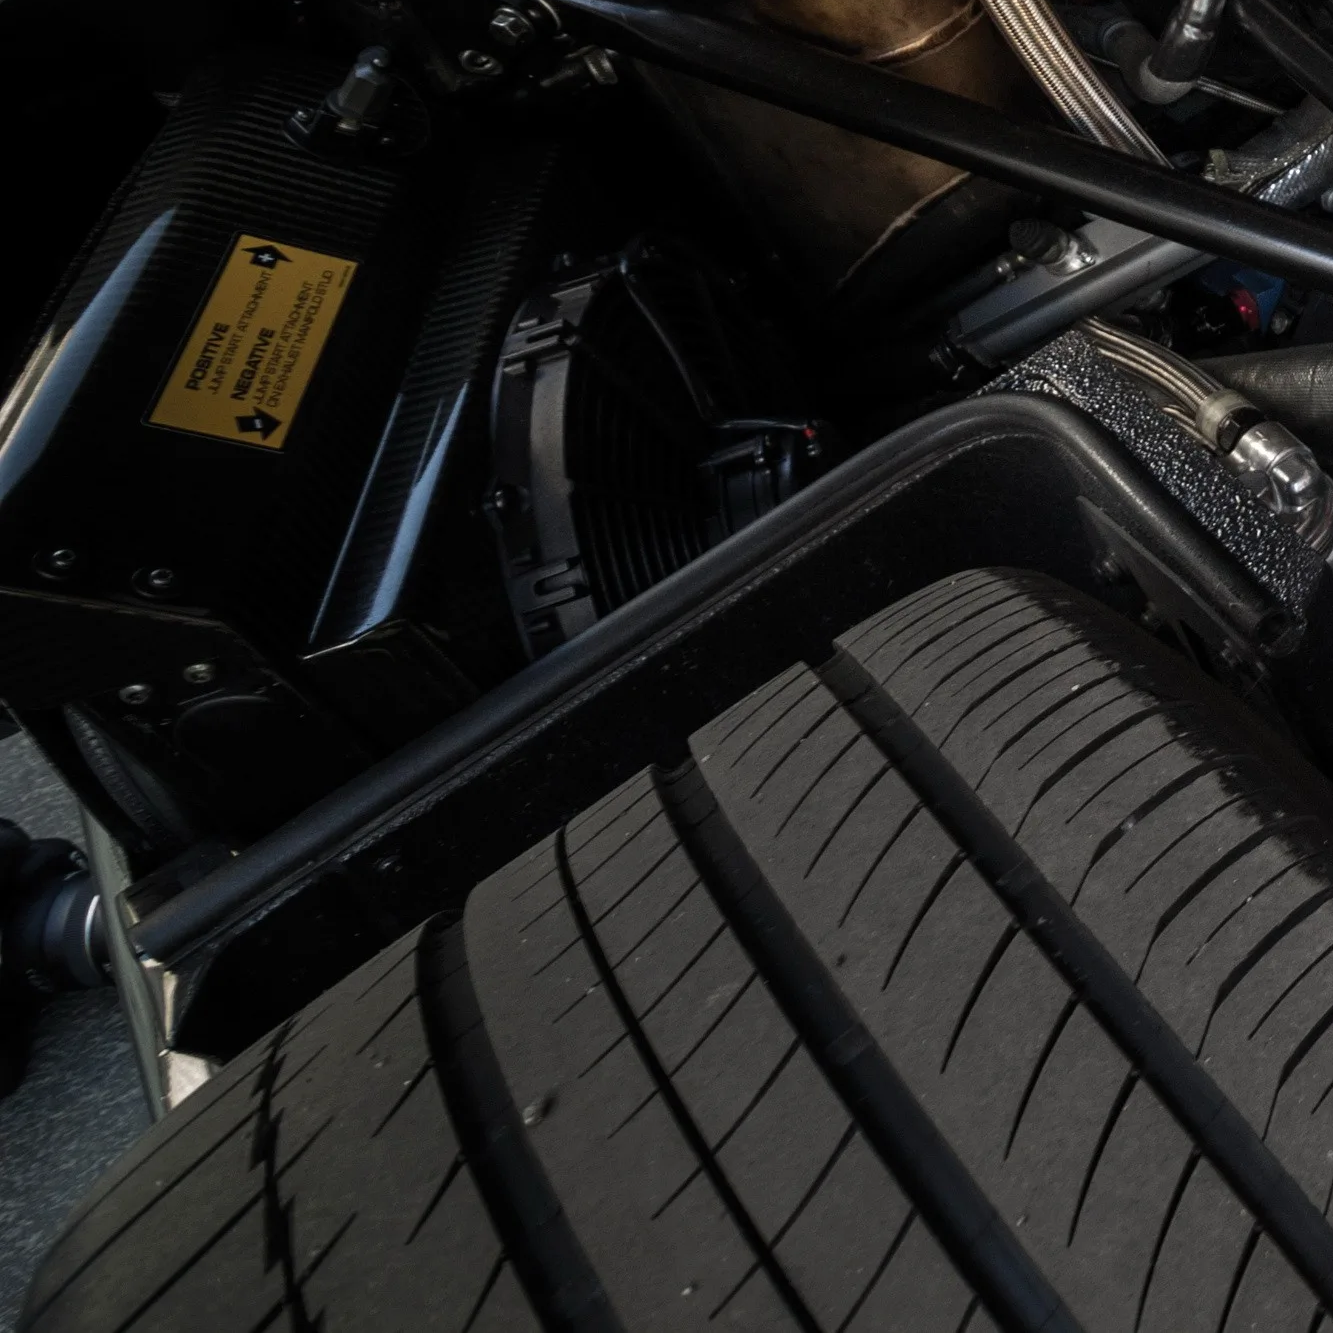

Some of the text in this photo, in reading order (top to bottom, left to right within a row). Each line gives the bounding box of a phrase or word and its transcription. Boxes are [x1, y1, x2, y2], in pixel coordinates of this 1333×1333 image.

[186, 322, 230, 390] POSITIVE
[207, 364, 227, 394] JUMP
[220, 333, 243, 363] START
[229, 327, 274, 401] NEGATIVE
[252, 374, 271, 404] JUMP
[264, 342, 285, 374] START
